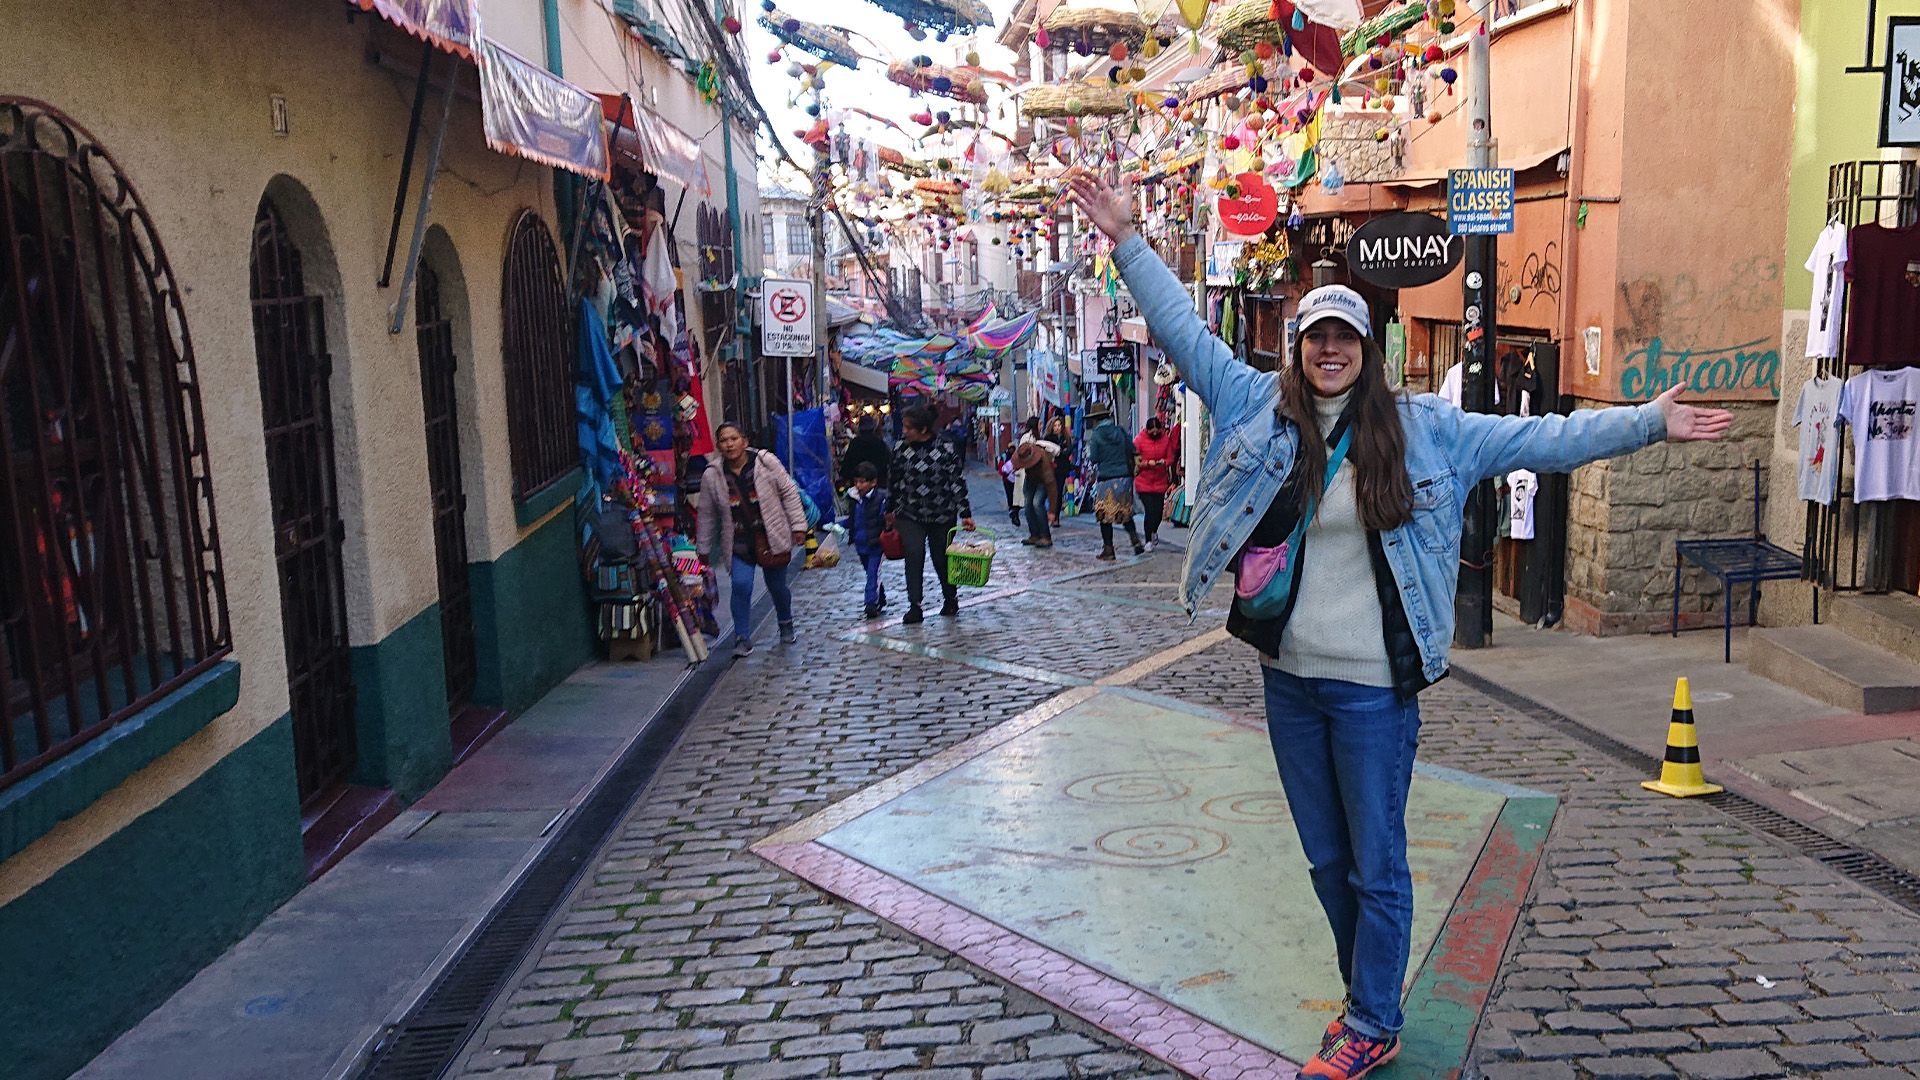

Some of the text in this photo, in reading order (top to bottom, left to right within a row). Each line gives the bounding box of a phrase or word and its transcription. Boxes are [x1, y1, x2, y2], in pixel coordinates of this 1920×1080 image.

[1453, 170, 1511, 189] SPANISH
[1452, 191, 1511, 211] CLASSES
[1236, 211, 1260, 224] epic
[1489, 222, 1507, 231] street
[1360, 234, 1454, 264] MUNAY
[1361, 259, 1442, 270] outfit design
[783, 325, 794, 333] NO
[767, 333, 810, 342] ESTACIONAR
